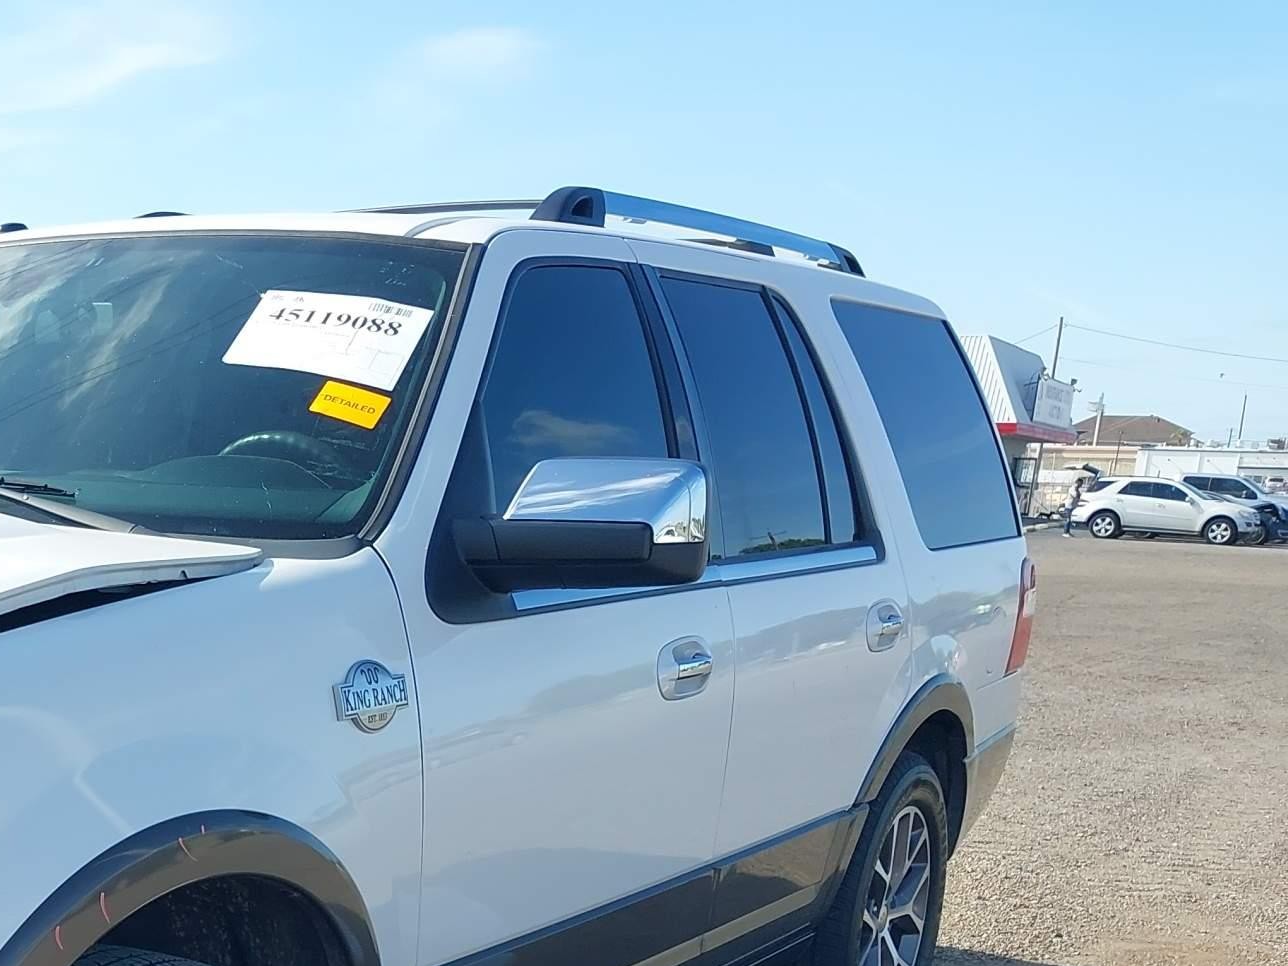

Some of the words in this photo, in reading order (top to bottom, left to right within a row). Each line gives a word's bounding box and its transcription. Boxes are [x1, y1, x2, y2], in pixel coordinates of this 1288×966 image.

[269, 307, 403, 336] 45119088
[323, 394, 377, 415] DETAILED
[343, 688, 372, 712] KING
[372, 679, 407, 707] RANCH
